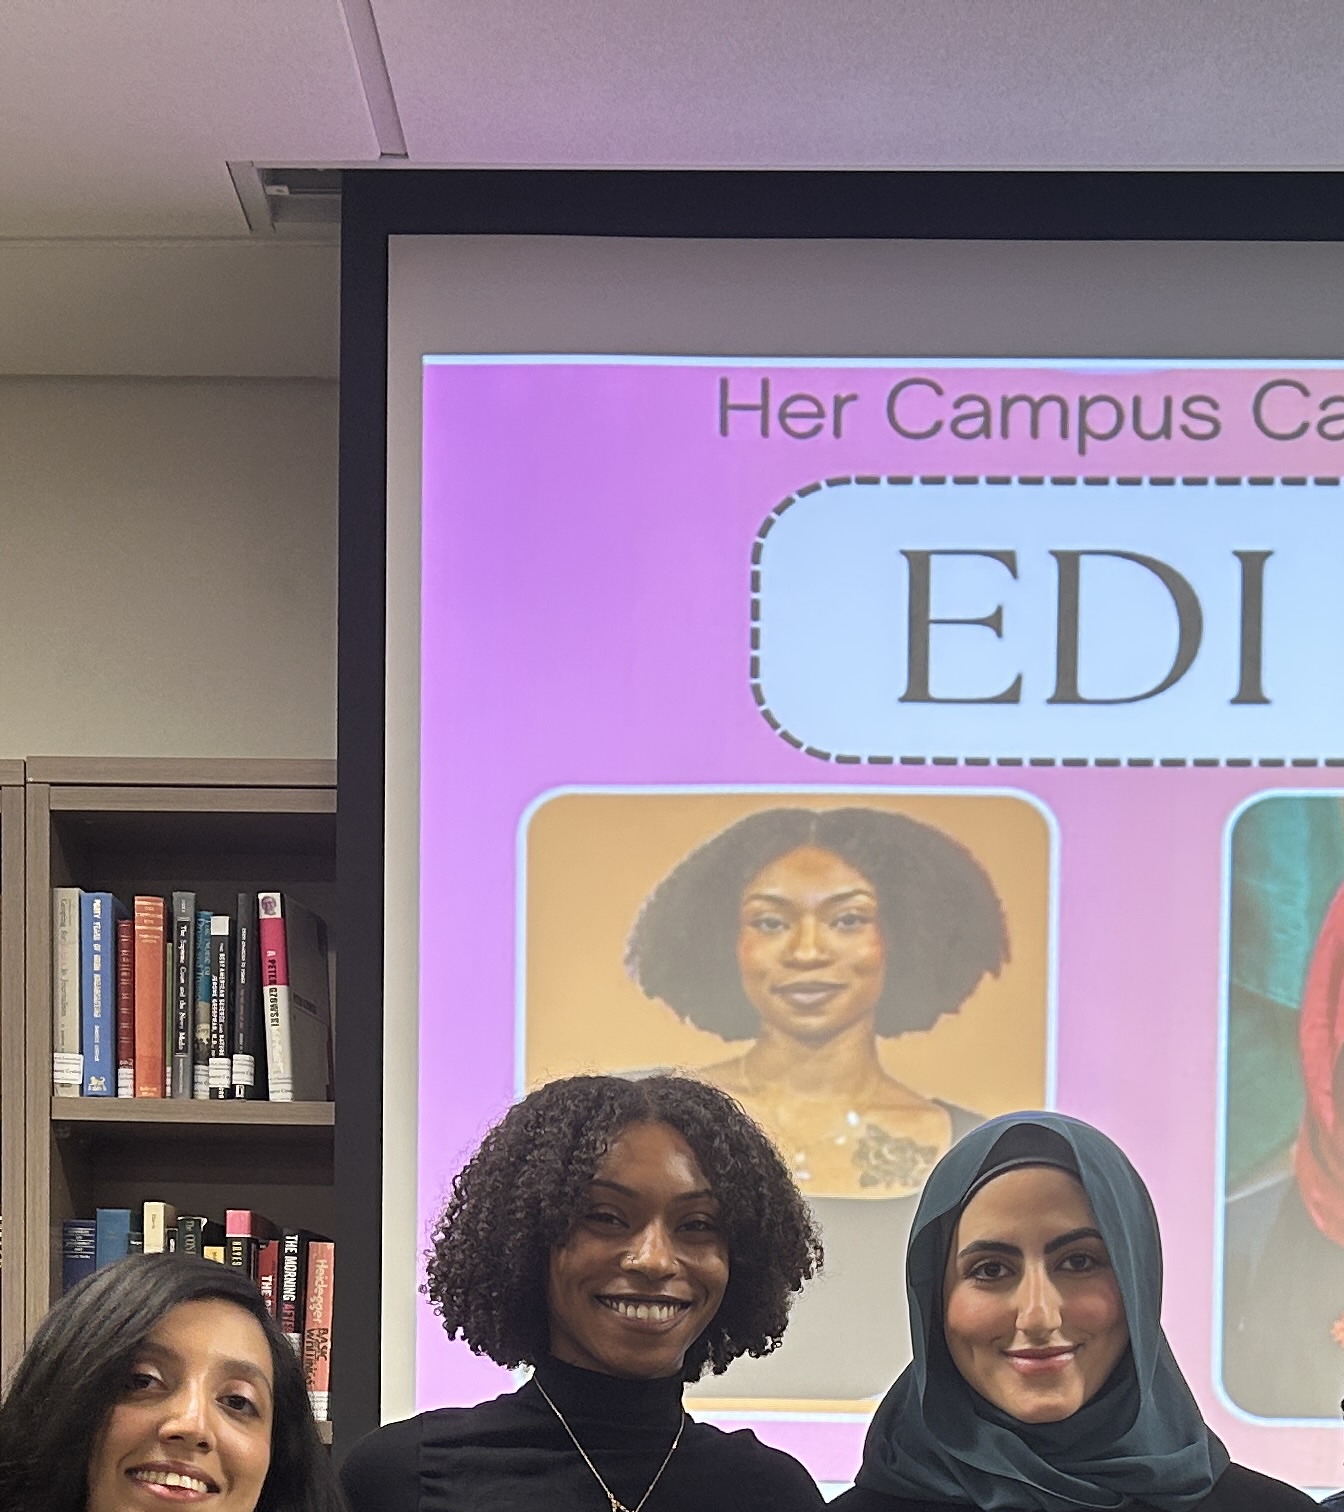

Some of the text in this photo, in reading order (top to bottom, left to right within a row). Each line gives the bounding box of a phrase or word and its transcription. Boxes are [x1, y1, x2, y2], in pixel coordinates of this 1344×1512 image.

[718, 377, 859, 440] Her
[886, 377, 1223, 456] Campus
[898, 548, 1275, 706] EDI
[177, 939, 186, 964] Supreme
[266, 959, 276, 985] PETER
[178, 1011, 186, 1029] News
[268, 986, 279, 1026] GZOWSKI
[178, 1032, 186, 1050] Media
[284, 1234, 298, 1254] THE
[260, 1274, 272, 1295] THE
[281, 1255, 297, 1301] MORNING
[307, 1257, 328, 1325] Heidegger
[314, 1326, 329, 1362] BASIC
